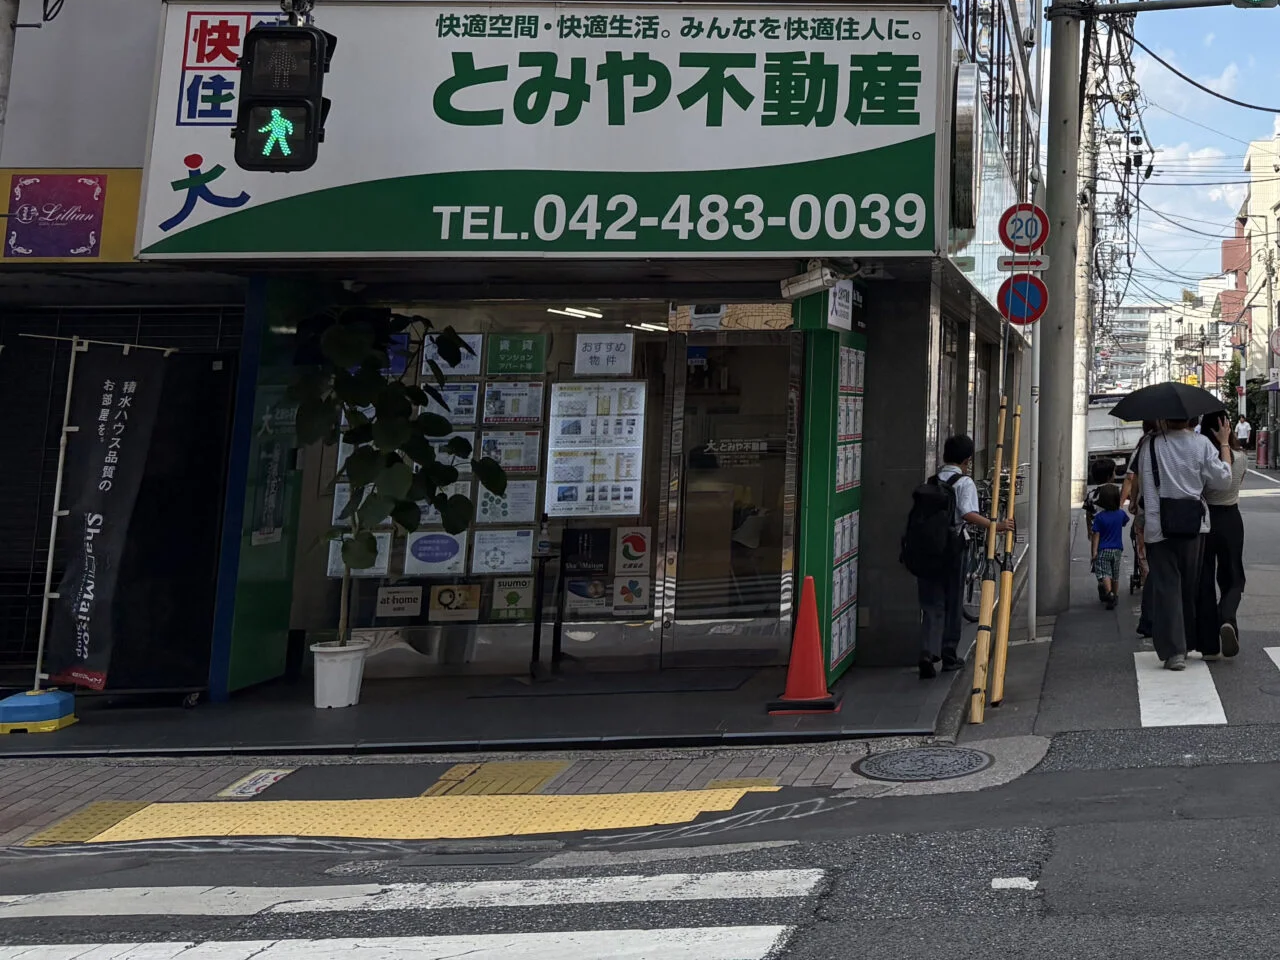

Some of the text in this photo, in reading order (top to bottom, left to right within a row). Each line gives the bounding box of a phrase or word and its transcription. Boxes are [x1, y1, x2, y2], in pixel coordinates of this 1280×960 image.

[432, 51, 922, 127] とみや不動産
[39, 203, 94, 222] Lillian
[1010, 218, 1038, 239] 20
[581, 342, 626, 353] おすすめ
[99, 381, 137, 492] 積水ハウス品質の
